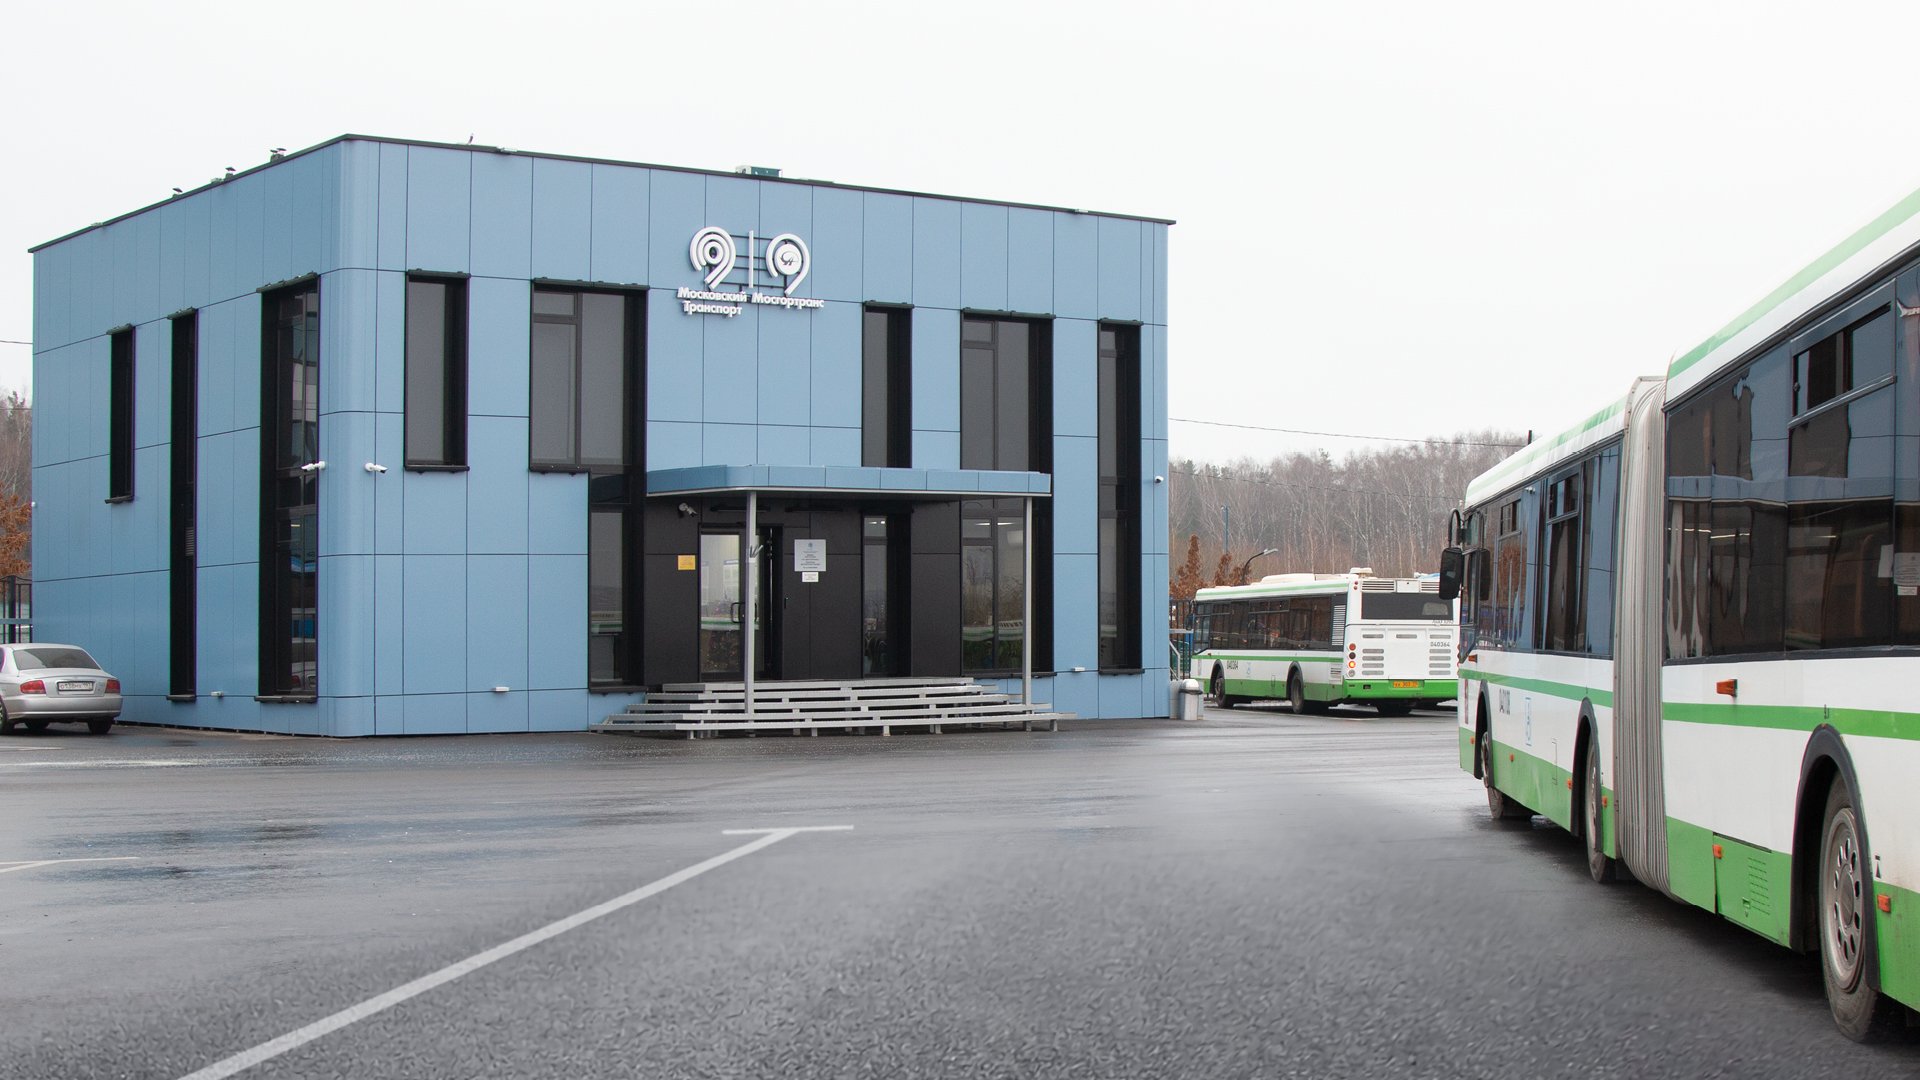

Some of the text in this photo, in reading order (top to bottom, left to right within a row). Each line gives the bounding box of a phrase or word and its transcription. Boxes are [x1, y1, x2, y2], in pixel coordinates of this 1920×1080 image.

[677, 287, 747, 303] Московский
[751, 292, 825, 310] Мосгортранс
[682, 300, 742, 317] Транспорт
